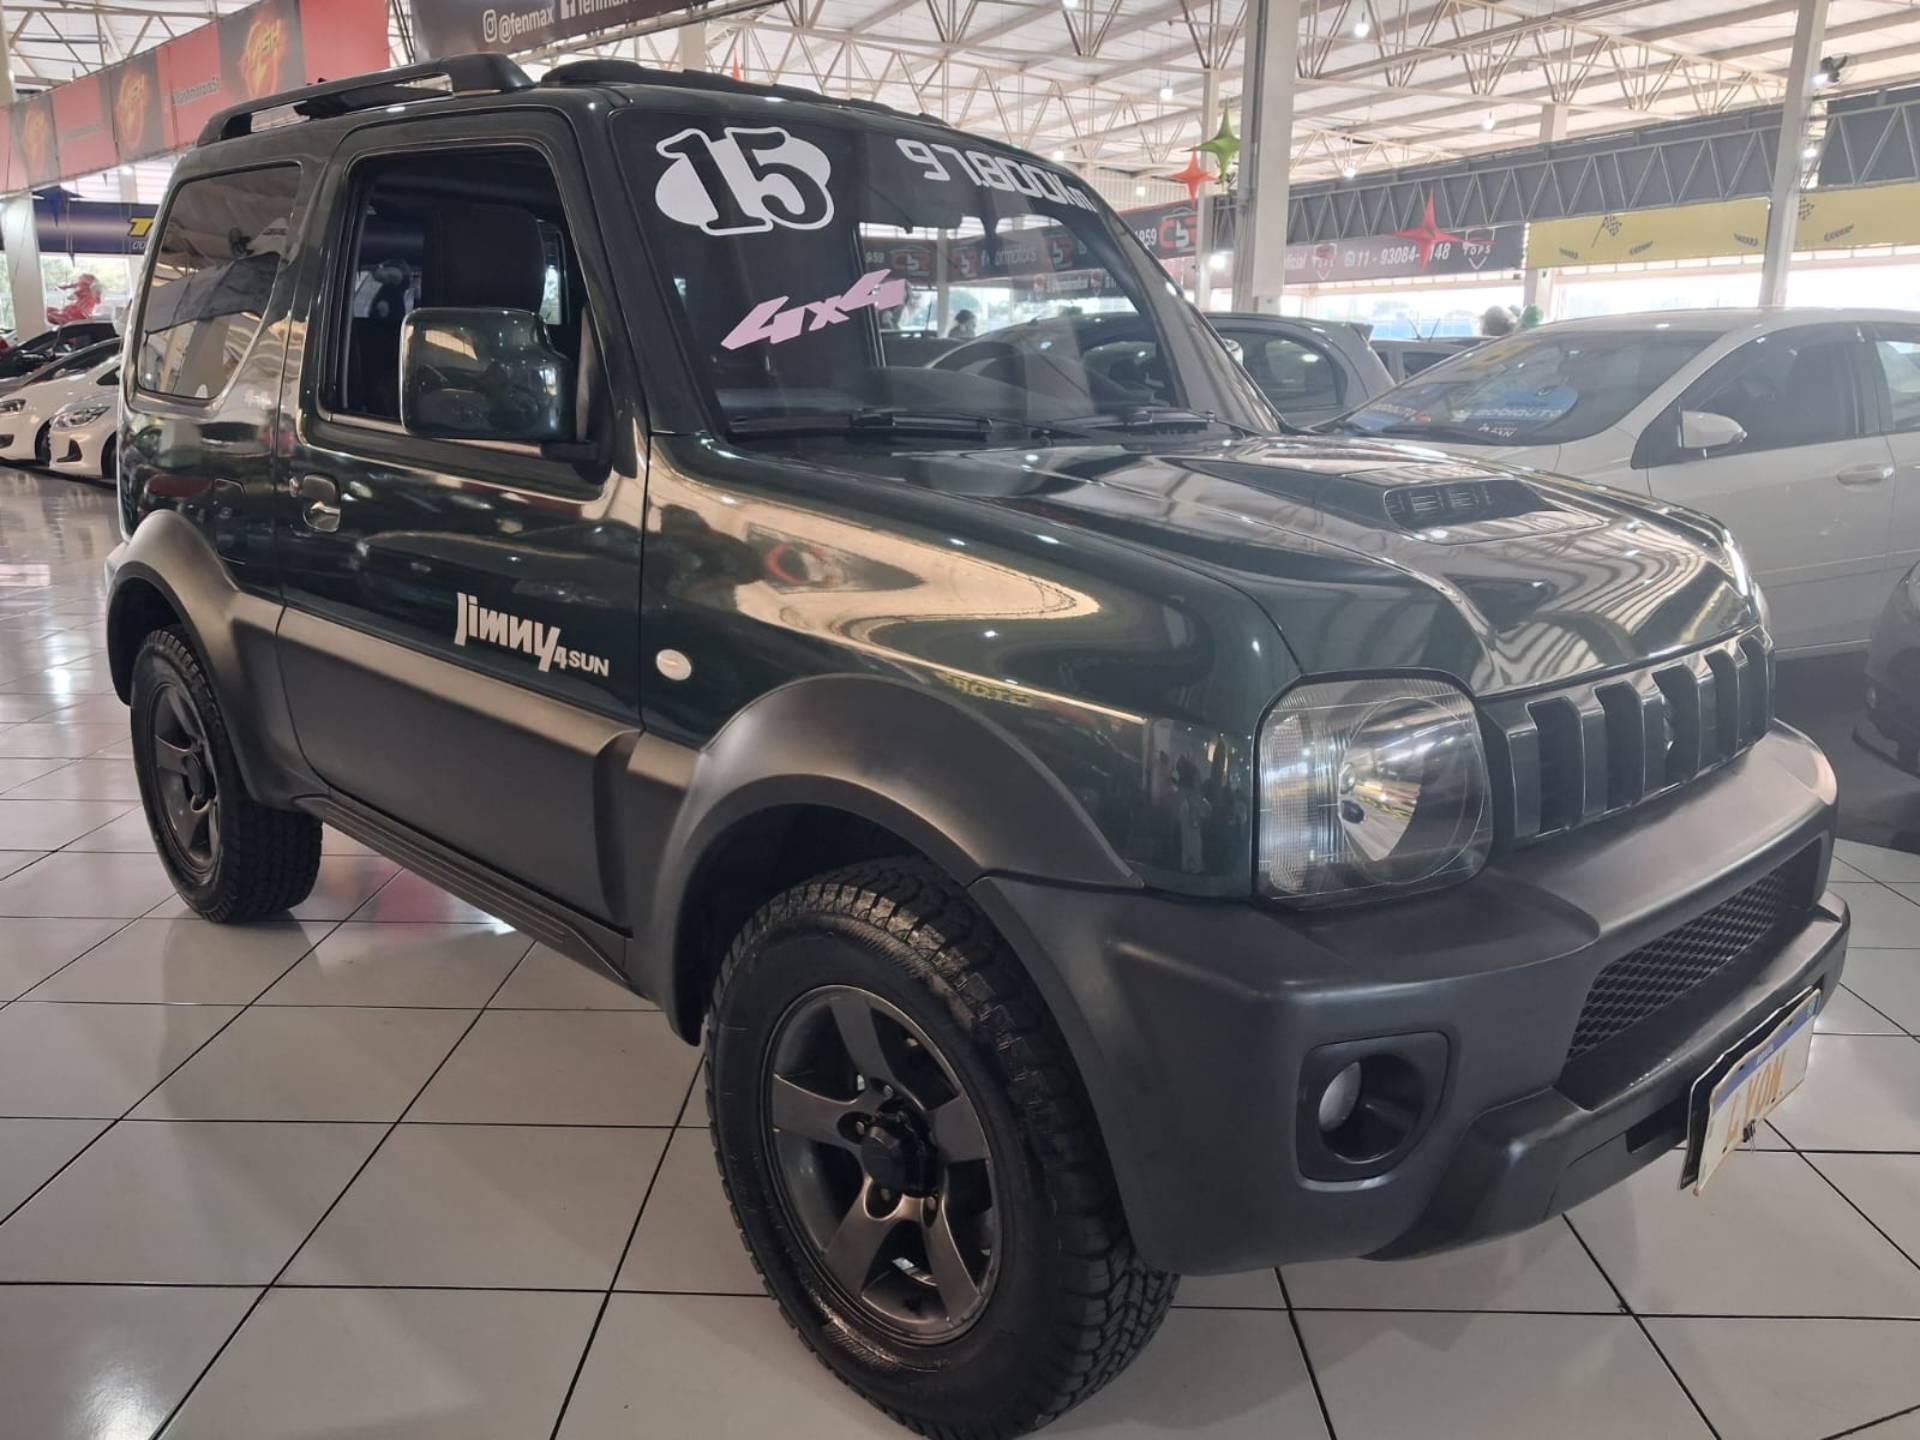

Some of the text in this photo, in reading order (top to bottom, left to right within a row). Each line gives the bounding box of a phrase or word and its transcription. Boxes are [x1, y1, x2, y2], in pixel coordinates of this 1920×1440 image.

[499, 9, 555, 43] @fenmax
[656, 126, 834, 236] 15
[1379, 243, 1451, 266] 93084-148
[720, 269, 908, 351] 4x4
[454, 592, 560, 672] Jimny
